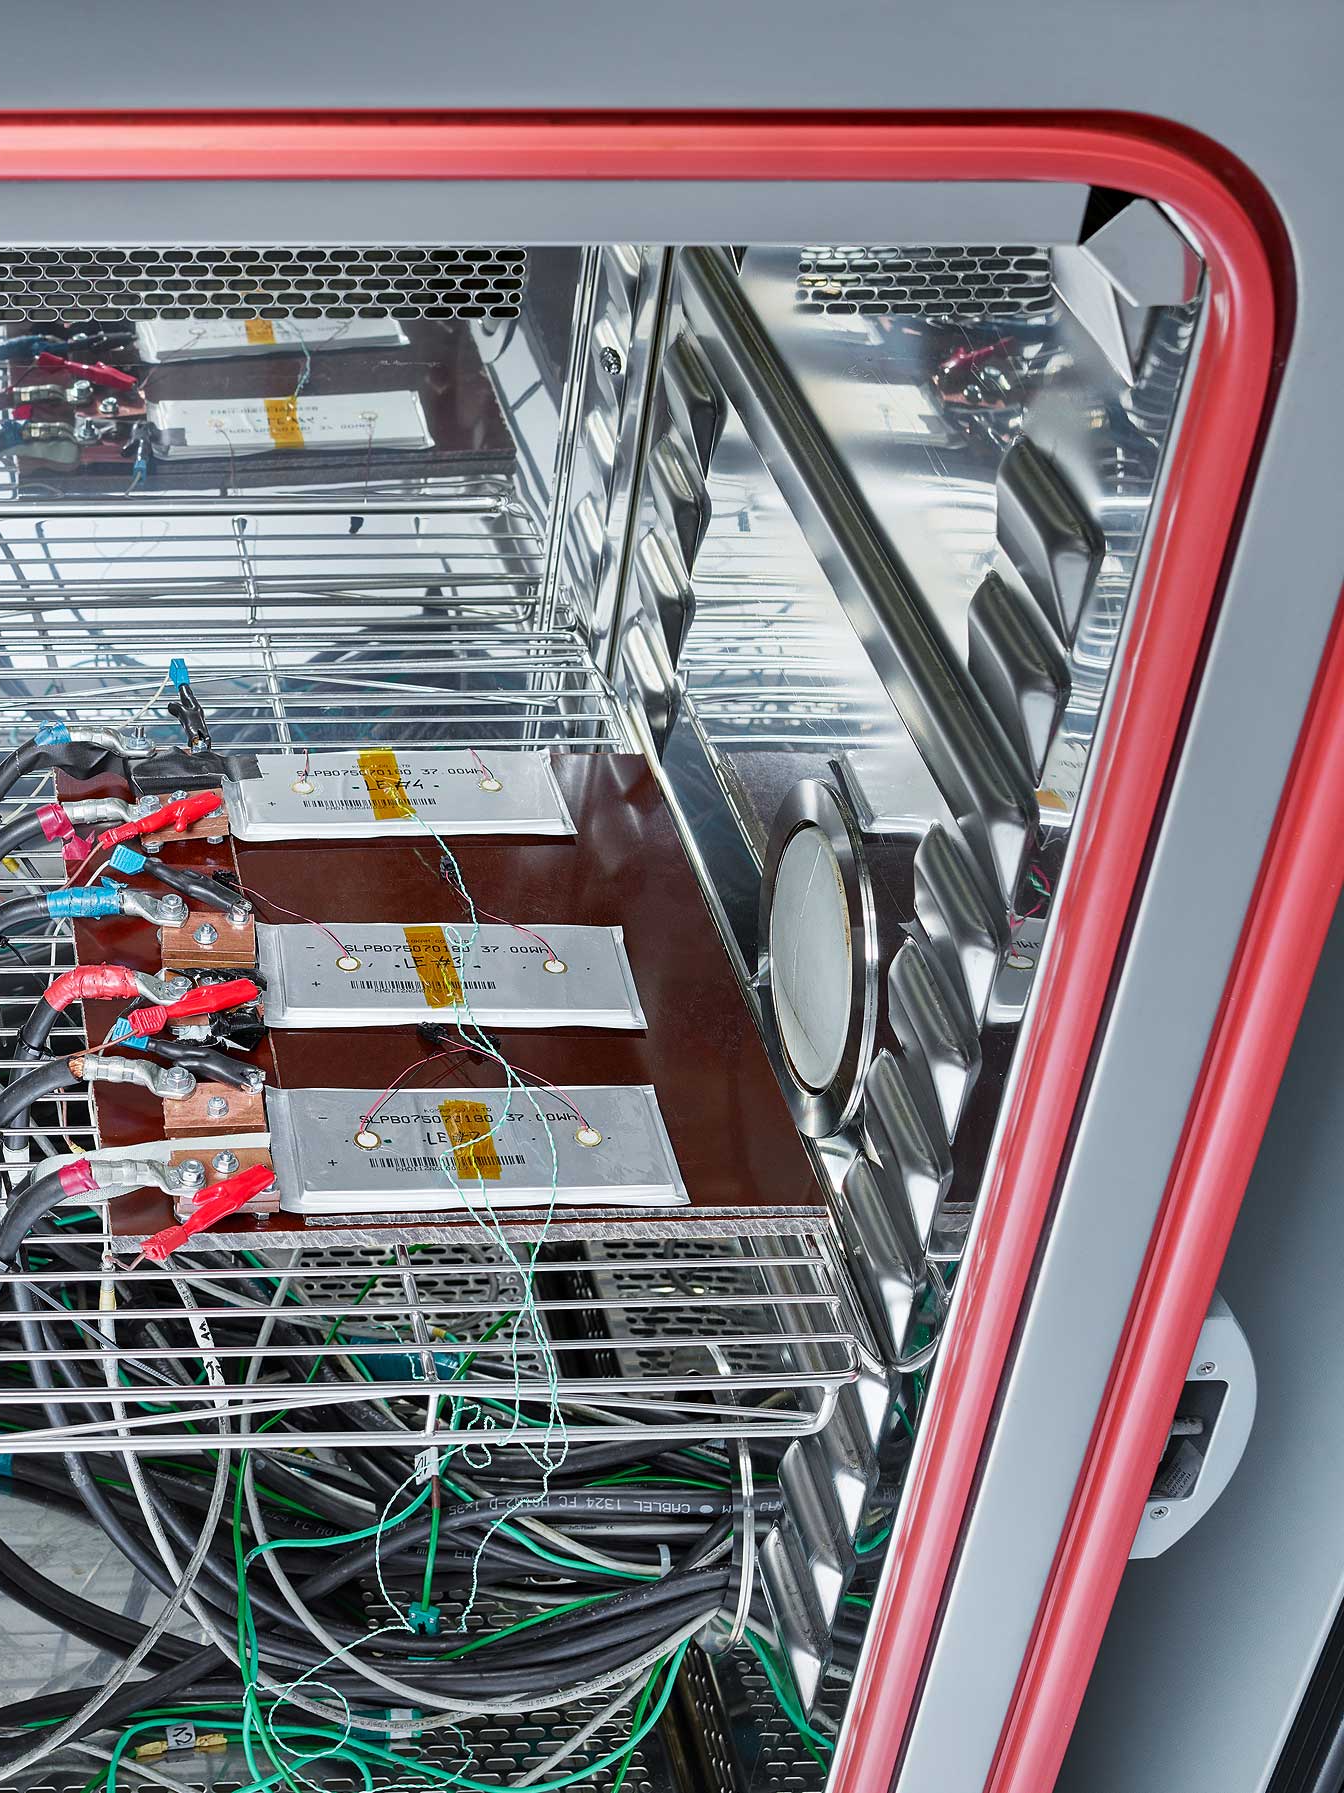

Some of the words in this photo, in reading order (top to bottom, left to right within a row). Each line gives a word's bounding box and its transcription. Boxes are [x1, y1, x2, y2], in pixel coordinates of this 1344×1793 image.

[344, 944, 470, 954] SLPB075070180
[359, 1114, 494, 1125] SLPB075070180
[558, 1495, 578, 1509] FC
[585, 1495, 623, 1511] 1324
[633, 1499, 692, 1515] CABLEL
